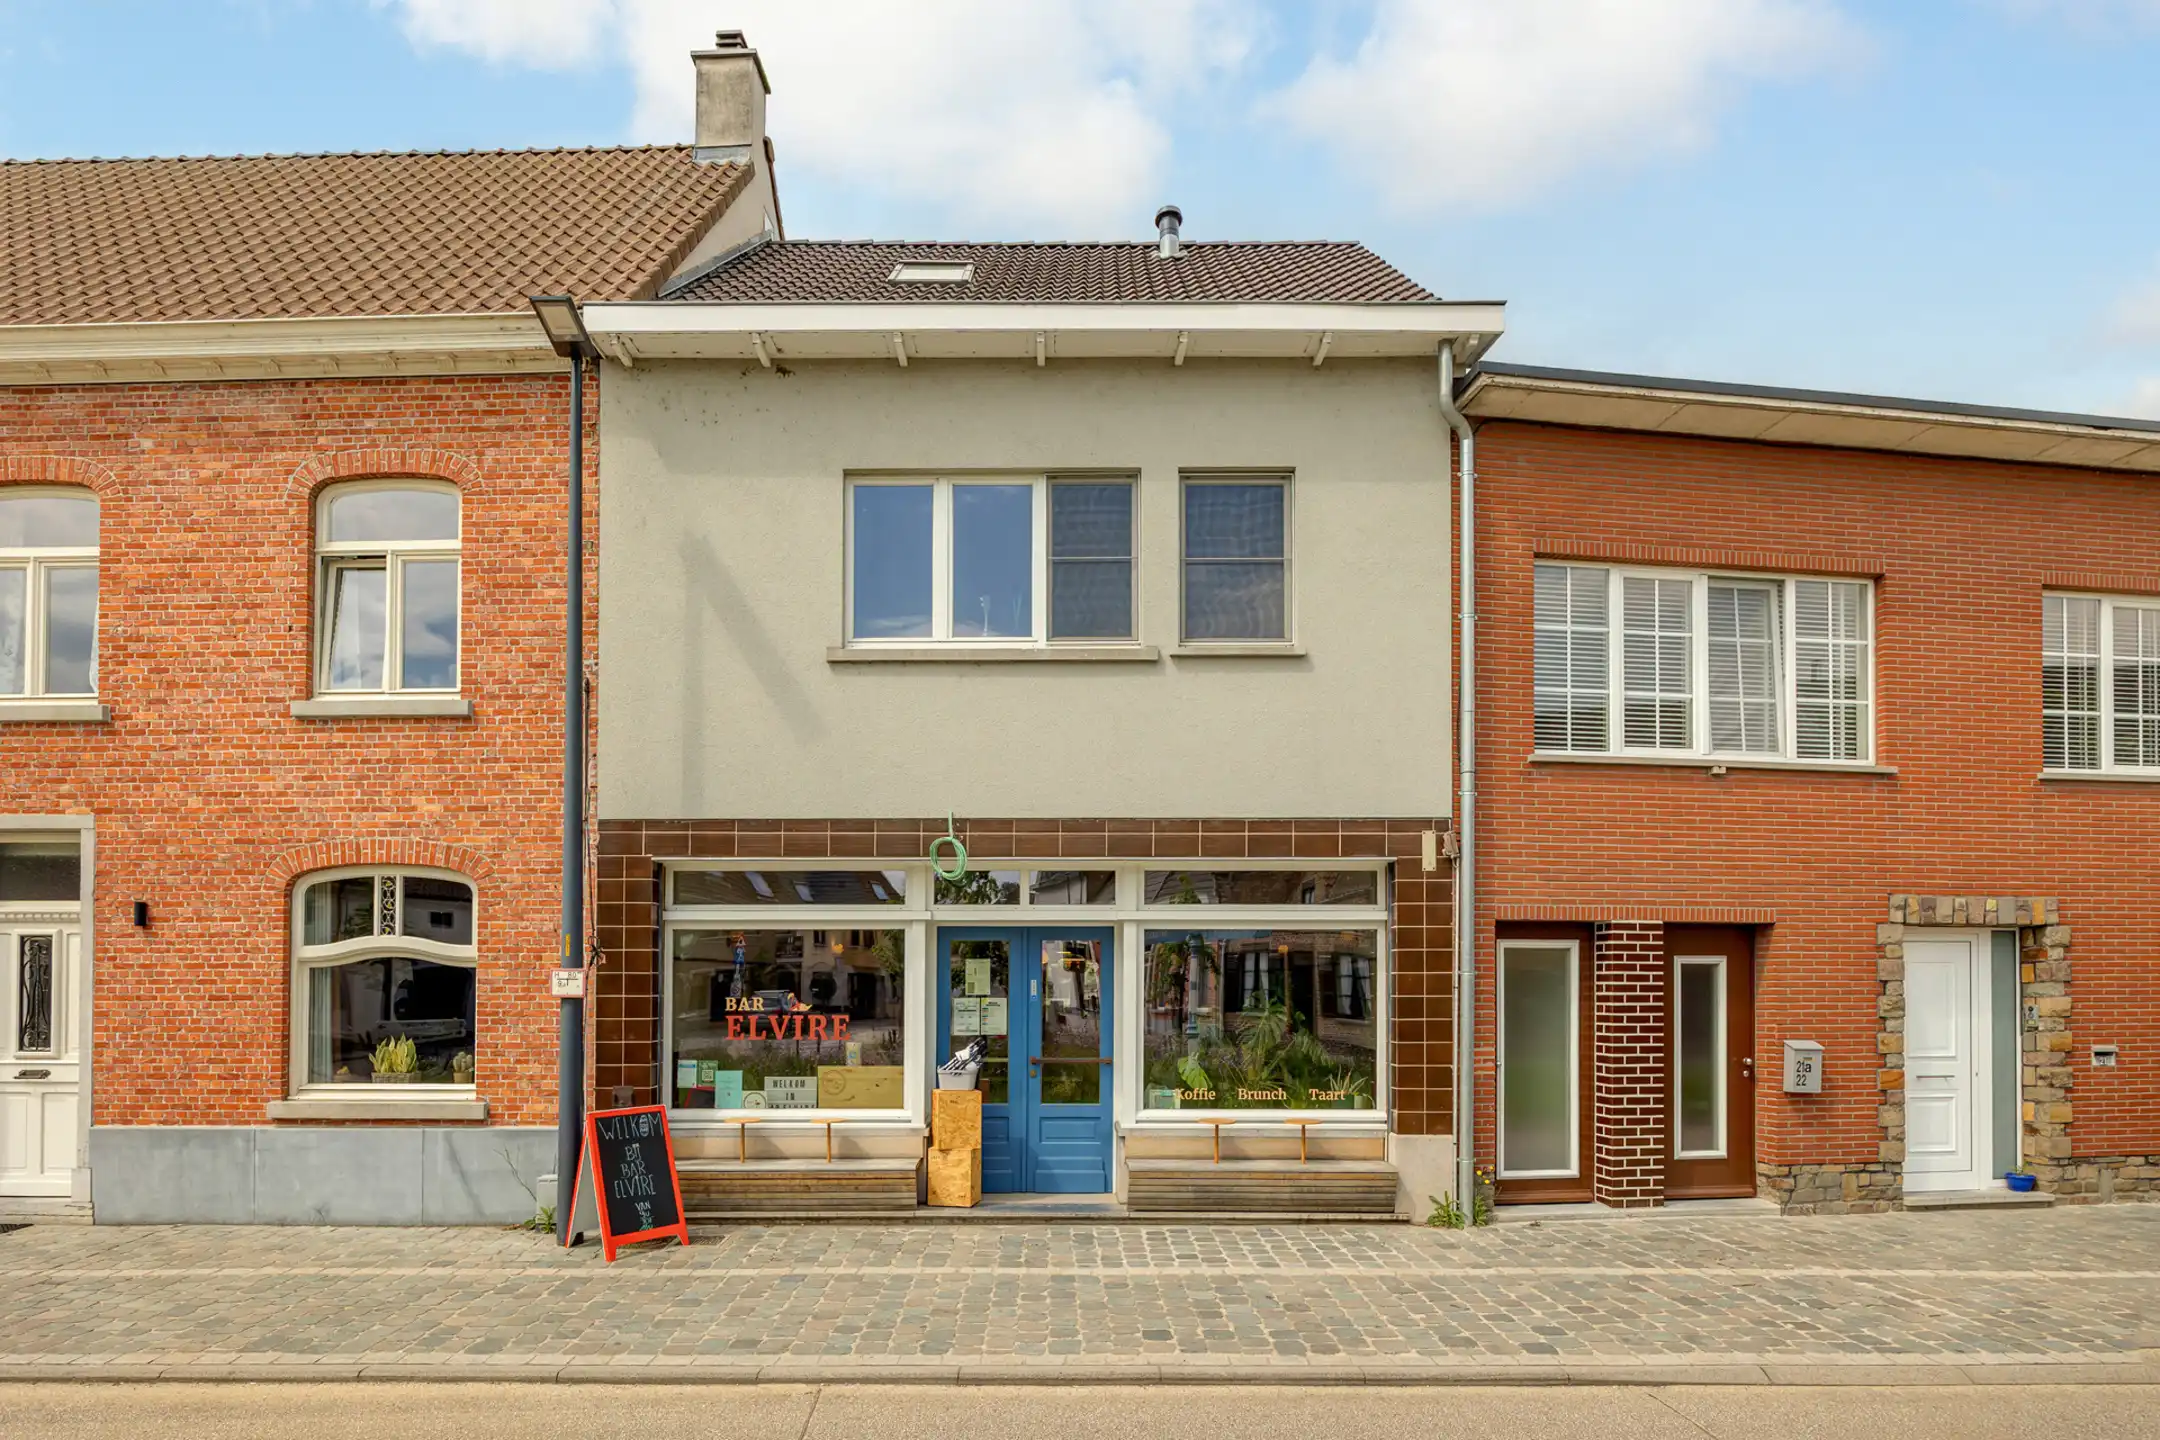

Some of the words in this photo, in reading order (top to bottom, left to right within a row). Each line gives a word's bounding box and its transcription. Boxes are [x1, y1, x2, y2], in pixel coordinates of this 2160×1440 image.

[554, 971, 560, 979] H
[725, 997, 765, 1011] BAR
[725, 1014, 851, 1041] ELVIRE
[1796, 1060, 1812, 1073] 21a
[772, 1079, 806, 1089] WELKOM
[1796, 1074, 1807, 1087] 22
[1175, 1087, 1217, 1100] Koffie
[1237, 1088, 1288, 1100] Brunch
[1308, 1088, 1347, 1101] Taart
[597, 1112, 664, 1140] WELKOM
[620, 1160, 647, 1179] BAR
[614, 1174, 657, 1199] ELVIRE
